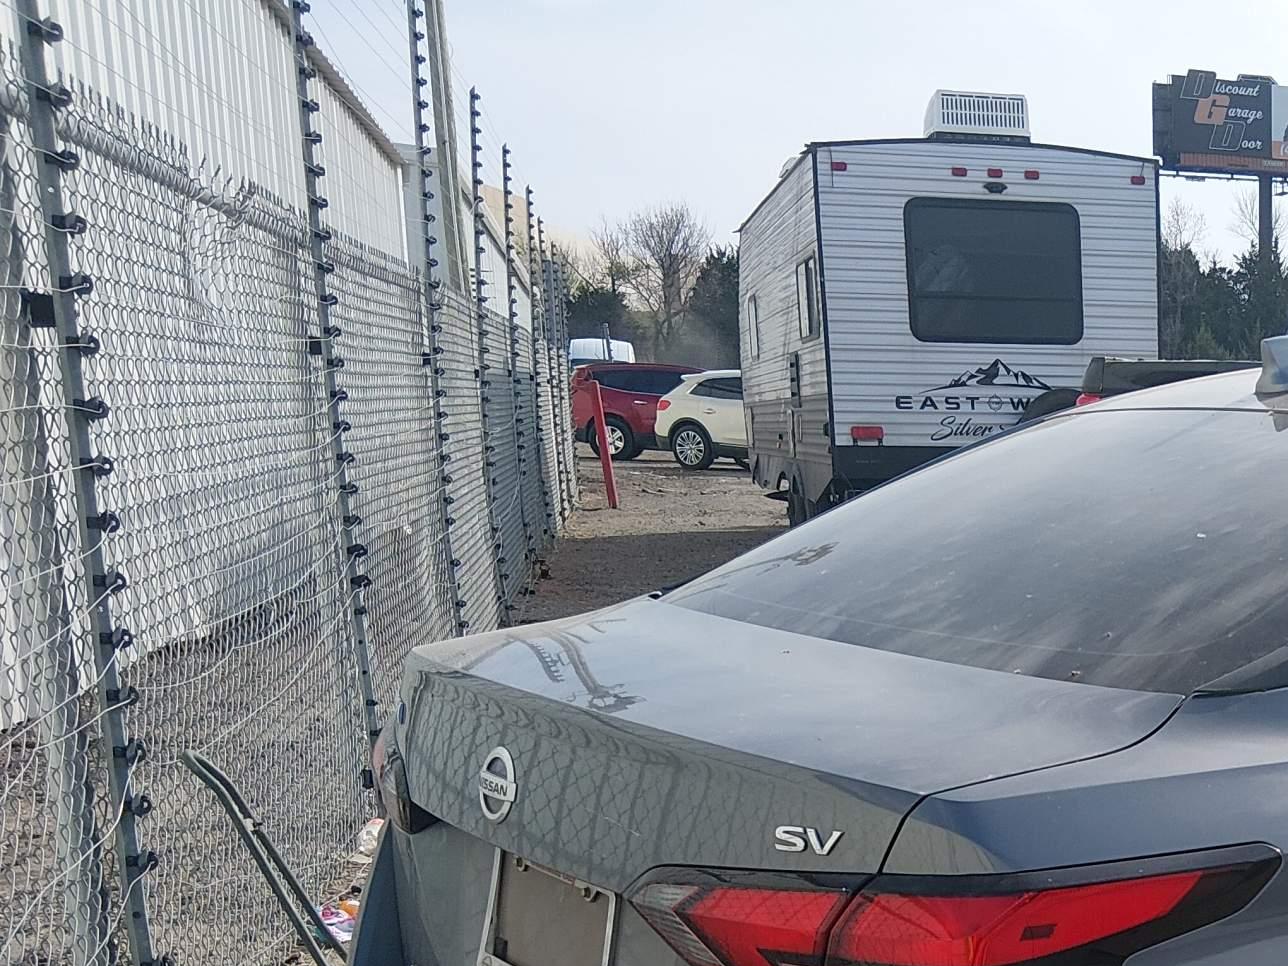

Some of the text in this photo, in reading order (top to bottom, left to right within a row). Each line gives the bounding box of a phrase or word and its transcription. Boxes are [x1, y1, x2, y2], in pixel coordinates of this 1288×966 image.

[1180, 69, 1260, 100] Discount
[1194, 95, 1263, 125] Garage
[1209, 120, 1263, 151] Door
[895, 395, 979, 411] EAST
[930, 415, 994, 442] Silver
[775, 825, 843, 856] SV
